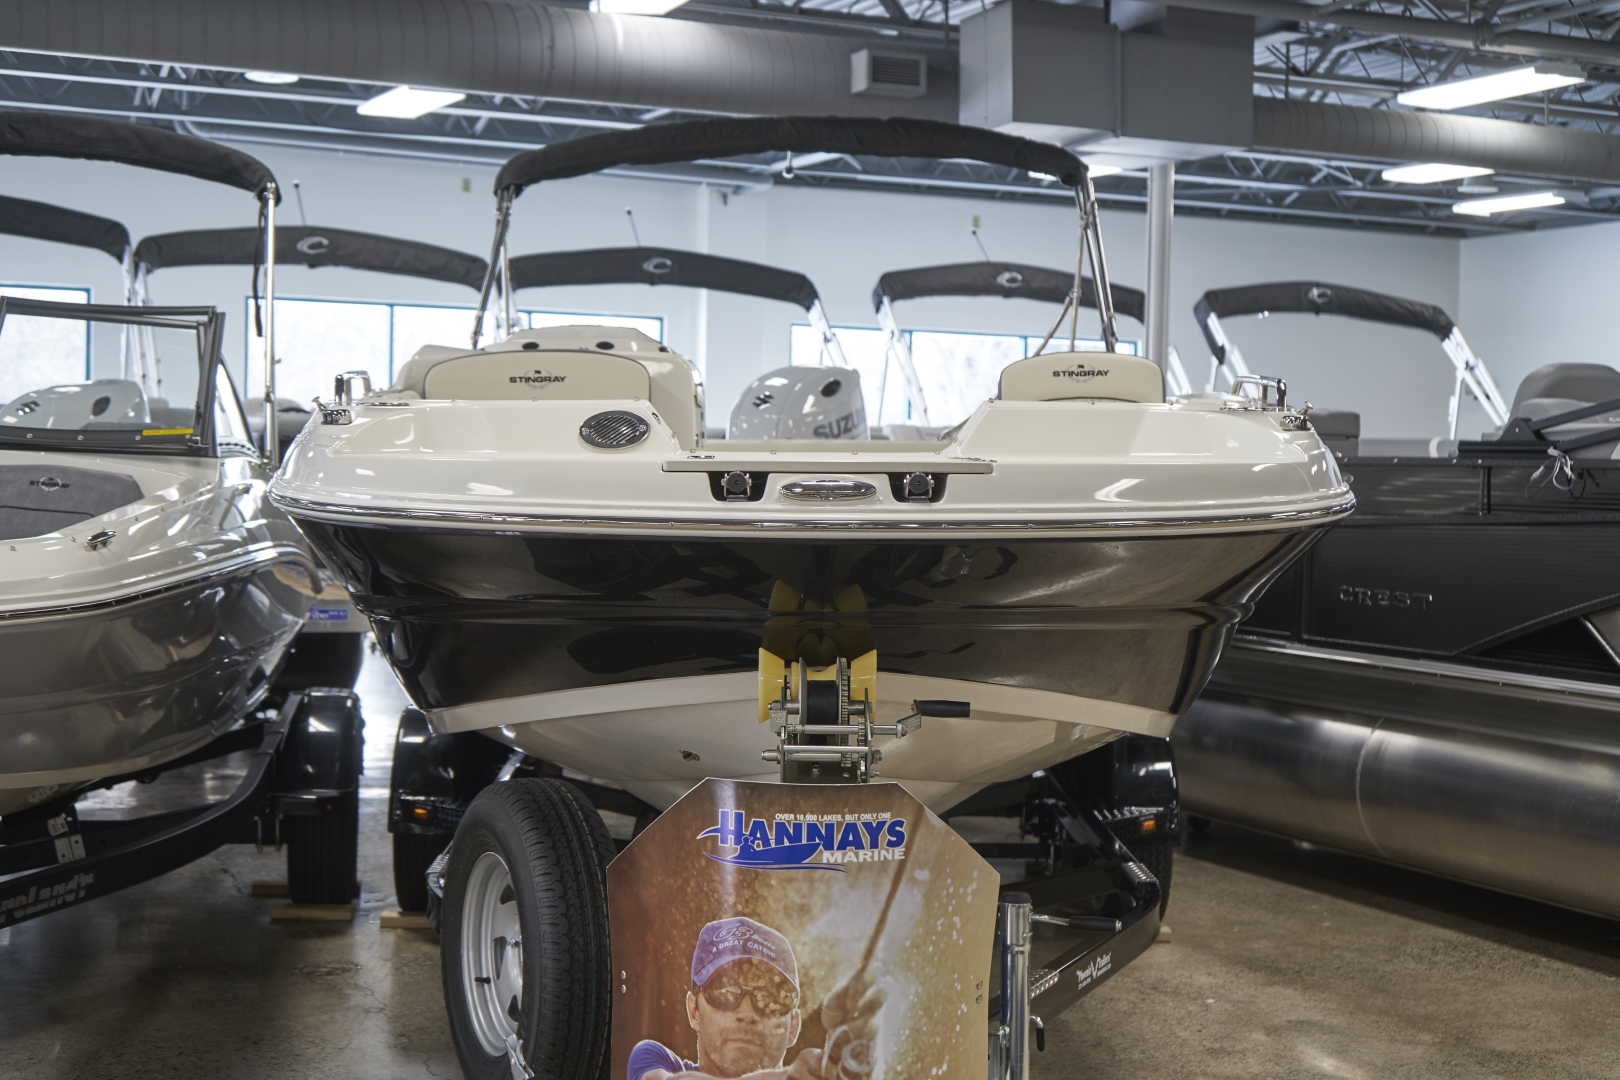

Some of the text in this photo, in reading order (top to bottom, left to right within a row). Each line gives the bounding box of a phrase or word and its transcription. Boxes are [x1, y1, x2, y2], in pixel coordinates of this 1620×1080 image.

[508, 375, 567, 384] STINGRAY
[1052, 369, 1110, 378] STINGRAY
[29, 480, 72, 489] STINGRAY
[1339, 585, 1433, 611] CREST
[775, 811, 892, 822] OVER 10,000 LAKES, BUT ONLY ONE
[697, 809, 906, 852] HANNAYS
[822, 848, 906, 863] MARINE
[712, 946, 718, 954] A
[718, 939, 744, 949] GREAT
